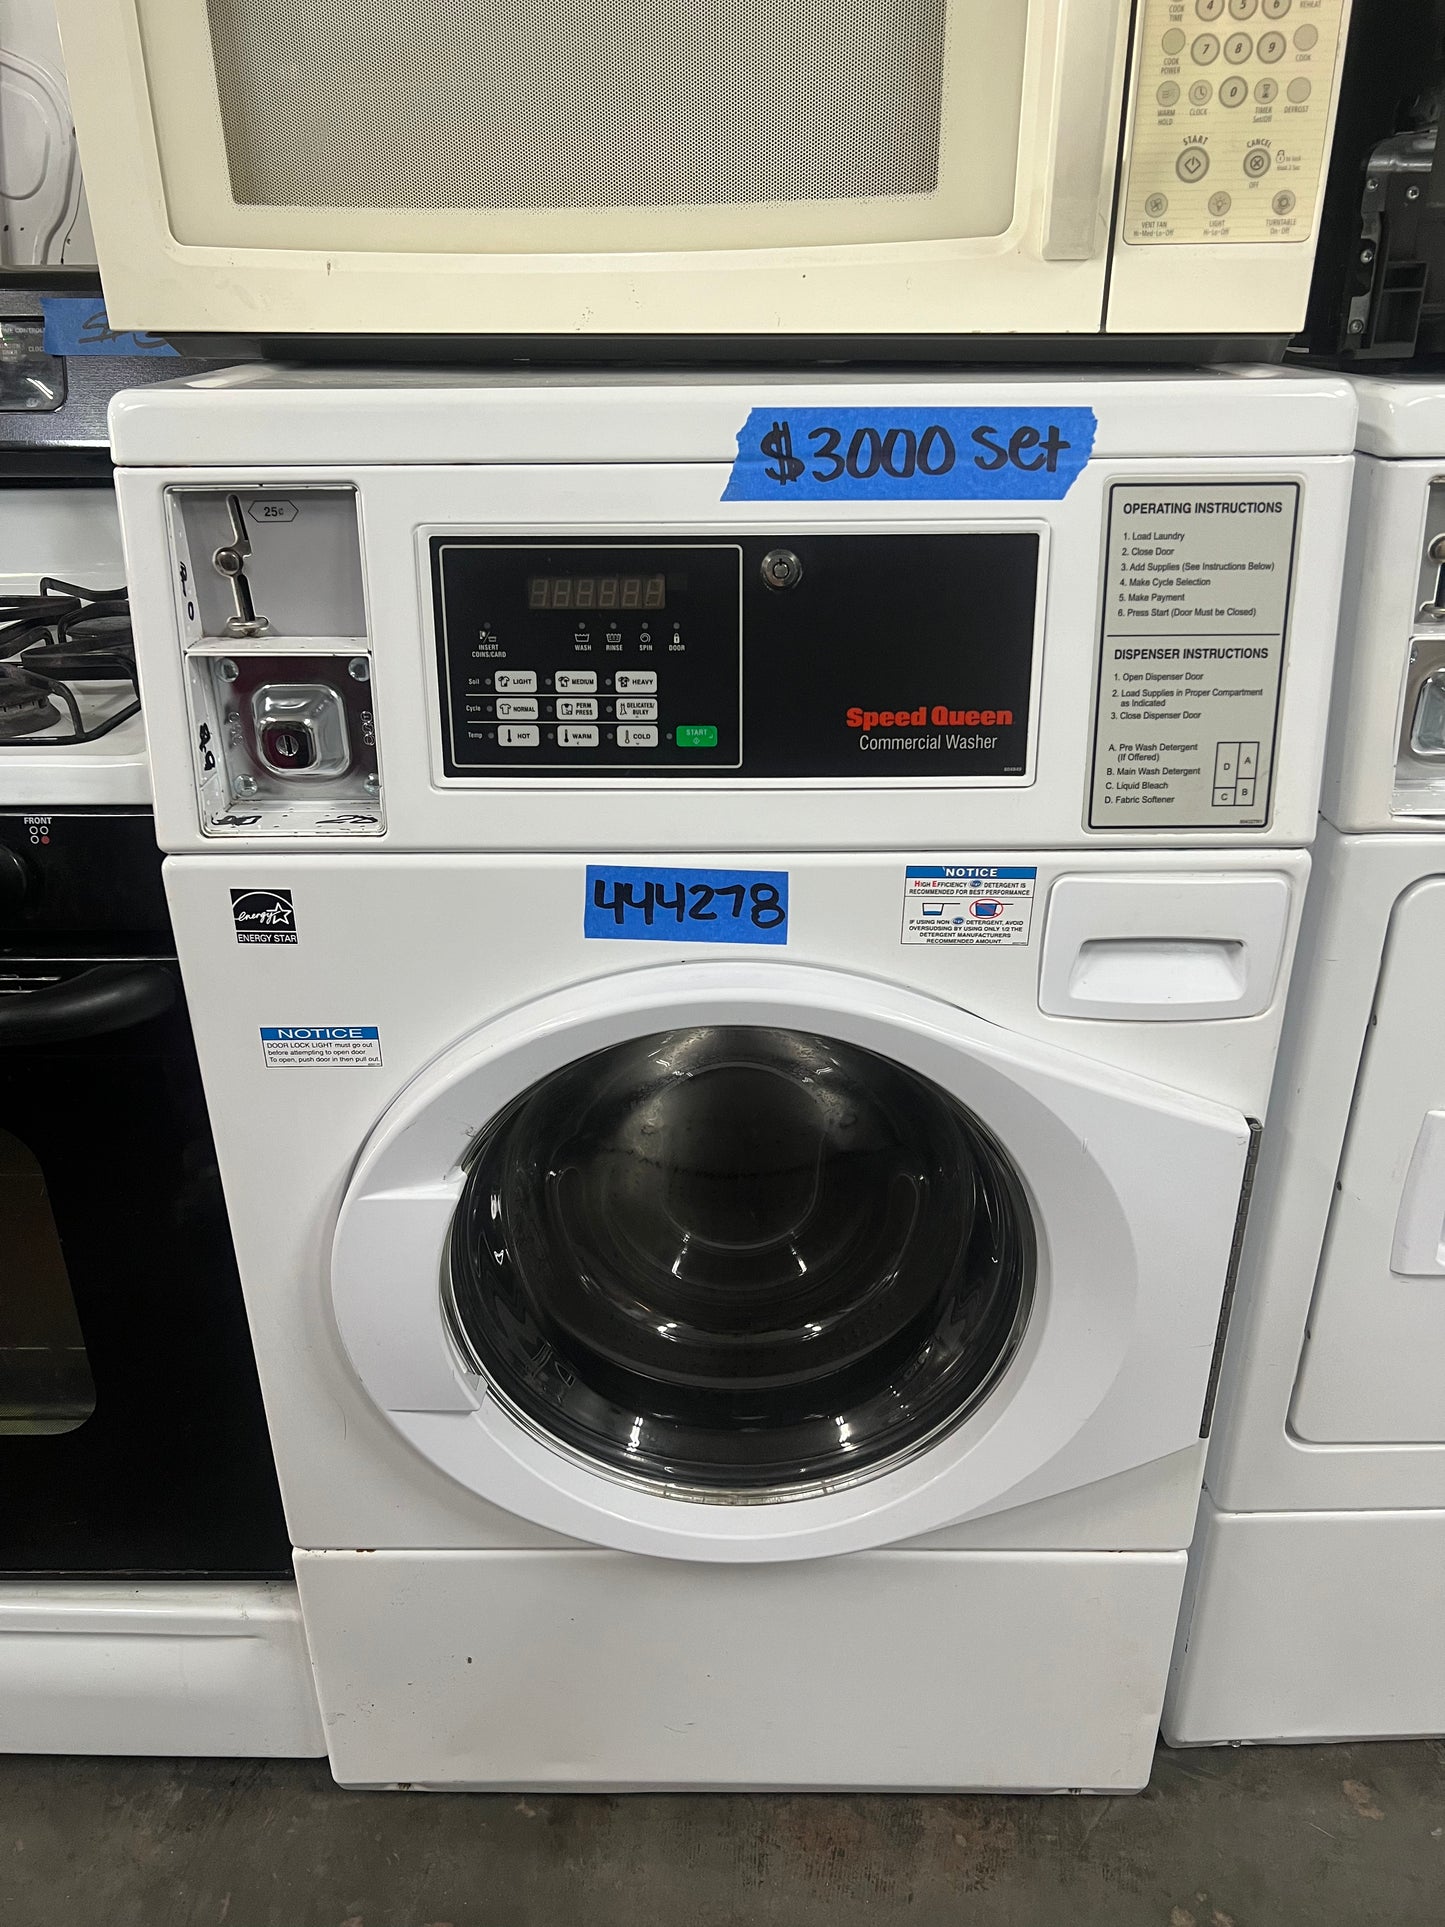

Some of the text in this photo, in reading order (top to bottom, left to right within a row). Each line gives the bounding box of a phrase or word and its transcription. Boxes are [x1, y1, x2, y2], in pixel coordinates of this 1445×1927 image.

[1202, 42, 1276, 54] 7 8 9
[1163, 57, 1179, 66] COOK
[1295, 54, 1312, 62] COOK
[1161, 66, 1181, 75] POWER
[1189, 108, 1208, 116] CLOCK
[1284, 105, 1309, 113] DEFROST
[1183, 135, 1209, 146] START
[1246, 139, 1272, 149] CANCEL
[1249, 181, 1259, 189] OFF
[1265, 218, 1297, 226] TURNTABLE
[760, 421, 956, 486] $3000
[263, 506, 284, 517] 25¢
[1123, 501, 1282, 515] OPERATING INSTRUCTIONS
[1123, 532, 1185, 542] 1. Load Laundry
[1122, 547, 1175, 556] 2. Close Door
[1121, 562, 1275, 573] 3. Add Supplies (See Instructions Below)
[1119, 578, 1211, 588] 4. Make Cycle Selection
[1118, 593, 1185, 604] 5. Make Payment
[1117, 608, 1256, 618] 6. Press Start (Door Must be Closed)
[1114, 648, 1268, 660] DISPENSER INSTRUCTIONS
[632, 678, 653, 686] HEAVY
[1114, 672, 1203, 682] 1. Open Dispenser Door
[1121, 689, 1140, 697] Load
[1142, 689, 1174, 698] Supplies
[1185, 689, 1210, 698] Proper
[1212, 688, 1263, 698] Compartment
[1132, 699, 1166, 707] Indicated
[466, 705, 481, 713] Cycle
[846, 706, 1013, 731] Speed Queen
[1111, 711, 1201, 721] 3. Close Dispenser Door
[686, 728, 708, 736] START
[859, 734, 997, 751] Commercial Washer
[1159, 743, 1198, 753] Detergent
[1117, 753, 1160, 763] (If Offered)
[1162, 767, 1200, 776] Detergent
[1223, 763, 1230, 771] D
[1105, 782, 1114, 790] C.
[1116, 782, 1140, 791] Liquid
[1242, 788, 1248, 796] B
[1115, 796, 1140, 804] Fabric
[945, 868, 998, 877] NOTICE
[914, 880, 931, 888] HIGH
[932, 880, 967, 888] EFFICIENCY
[593, 879, 785, 929] 444278
[236, 911, 275, 925] energy
[238, 934, 297, 943] ENERGY STAR
[277, 1028, 363, 1039] NOTICE
